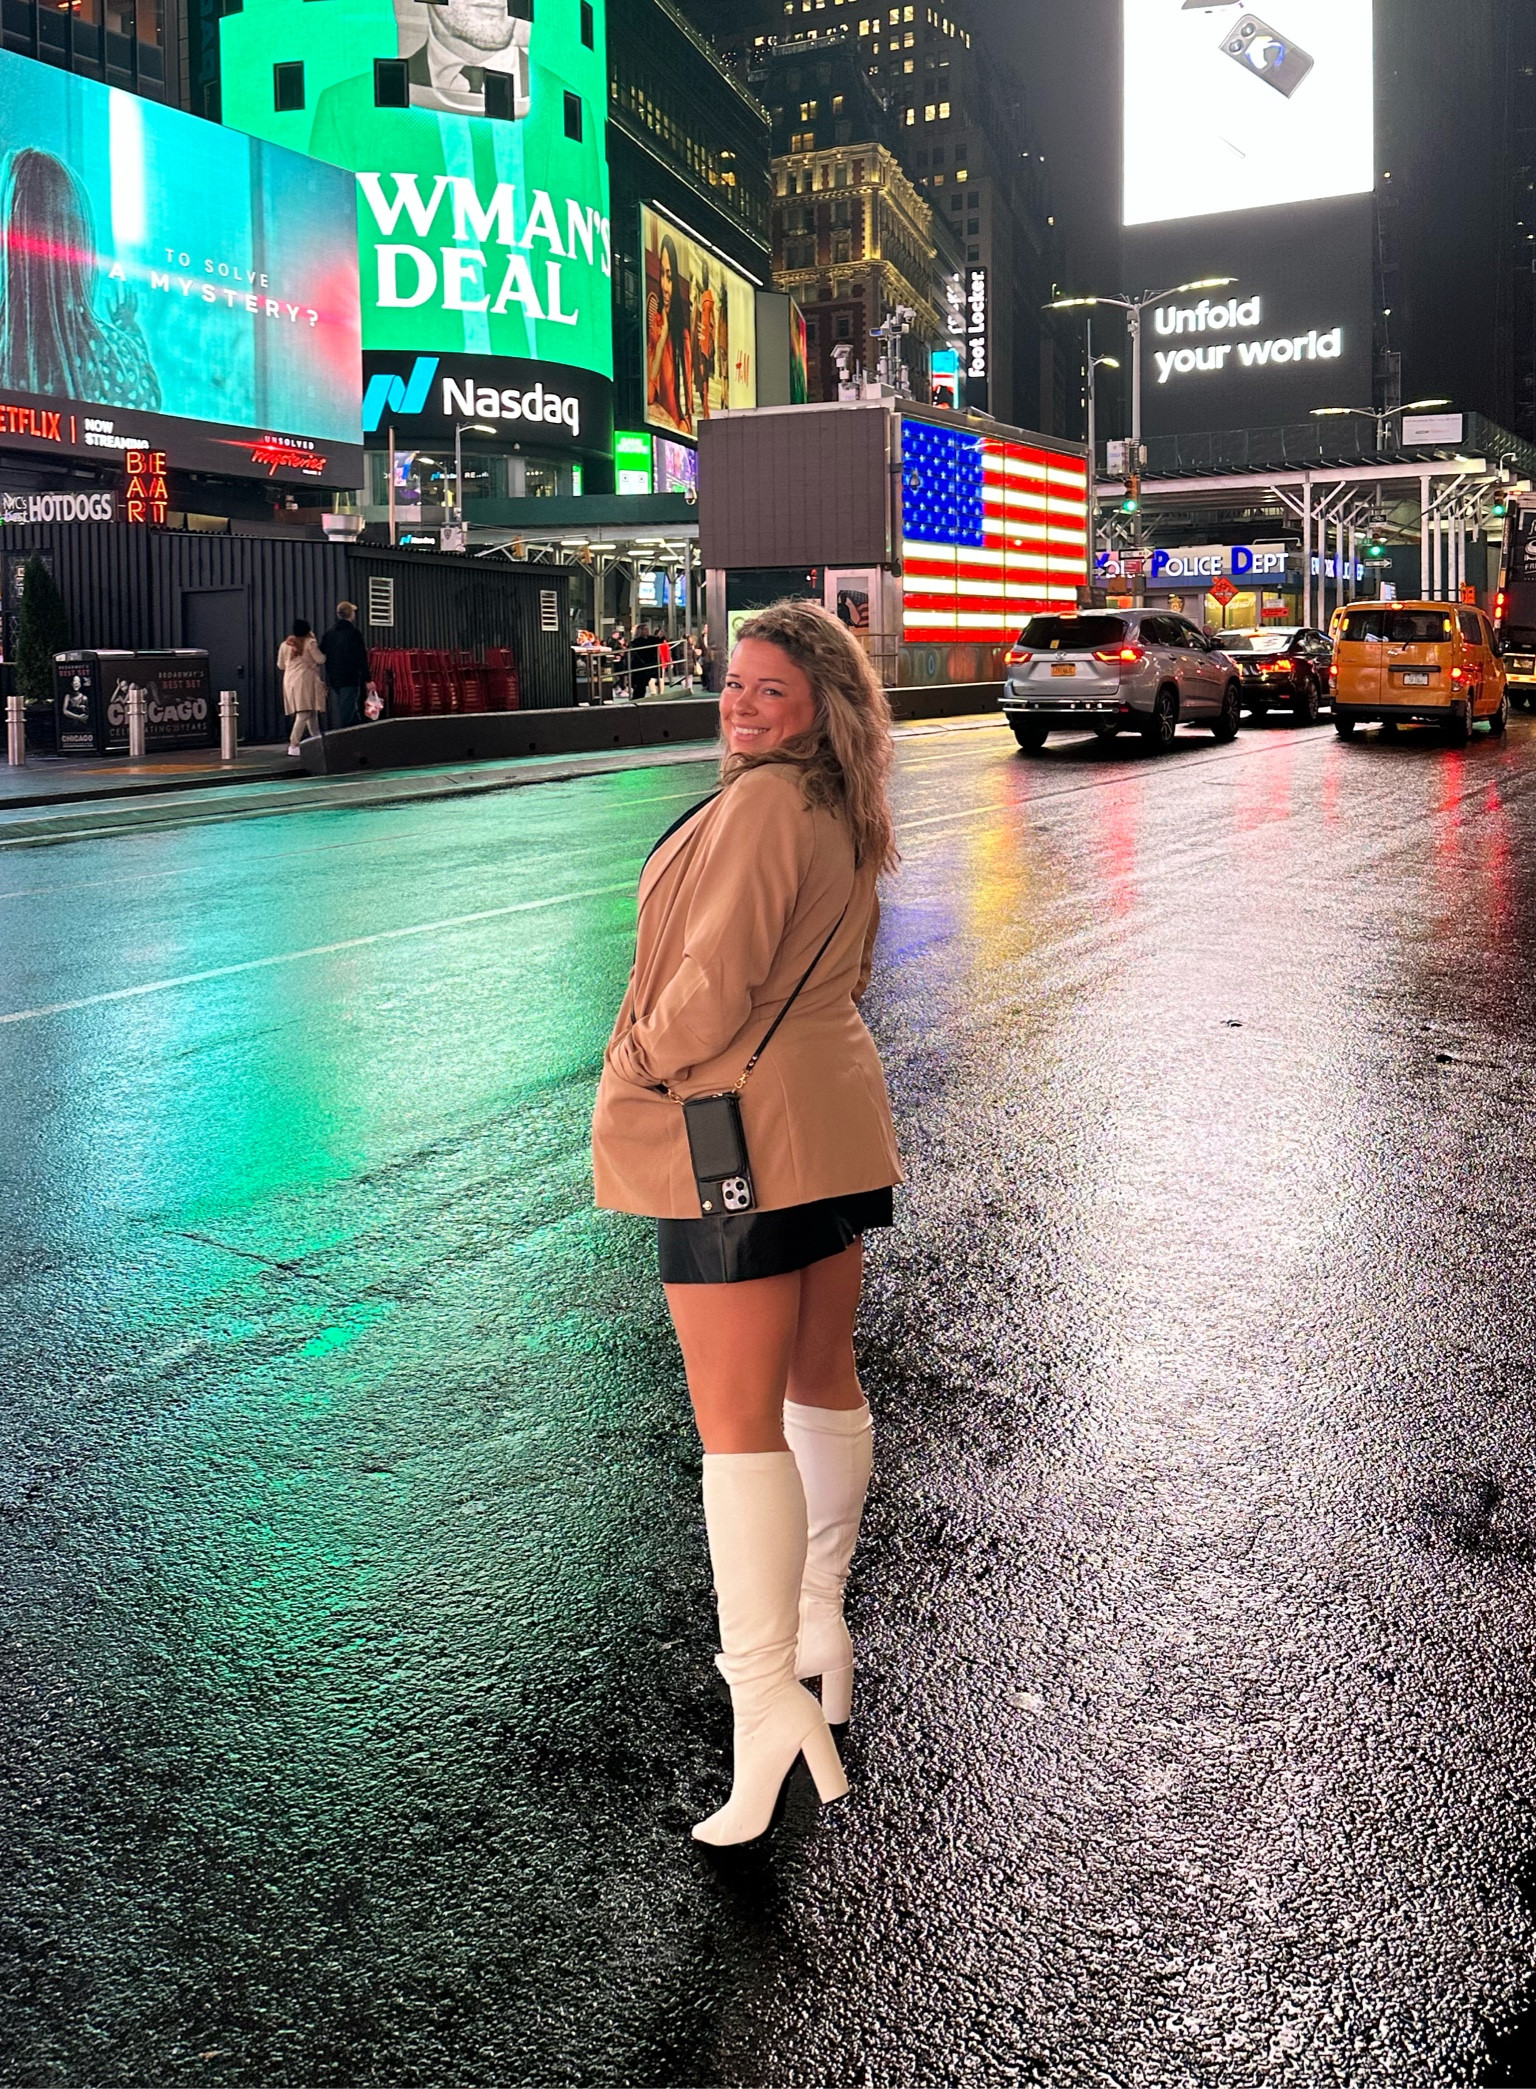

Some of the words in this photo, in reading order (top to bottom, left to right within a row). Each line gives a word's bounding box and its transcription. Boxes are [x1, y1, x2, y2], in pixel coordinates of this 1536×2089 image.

[165, 248, 191, 267] TO
[204, 259, 269, 288] SOLVE
[374, 244, 579, 325] DEAL
[108, 262, 126, 282] A
[150, 271, 319, 326] MYSTERY?
[1155, 295, 1261, 335] Unfold
[968, 337, 985, 378] Foot
[1154, 344, 1232, 384] your
[1237, 327, 1342, 367] world
[84, 418, 114, 434] NOW
[442, 378, 580, 436] Nasdaq
[84, 432, 150, 449] STREAMING
[264, 435, 315, 450] UNSOLVED
[29, 494, 112, 522] HOTDOGS
[1151, 550, 1222, 578] POLICE
[1231, 547, 1289, 575] DEPT
